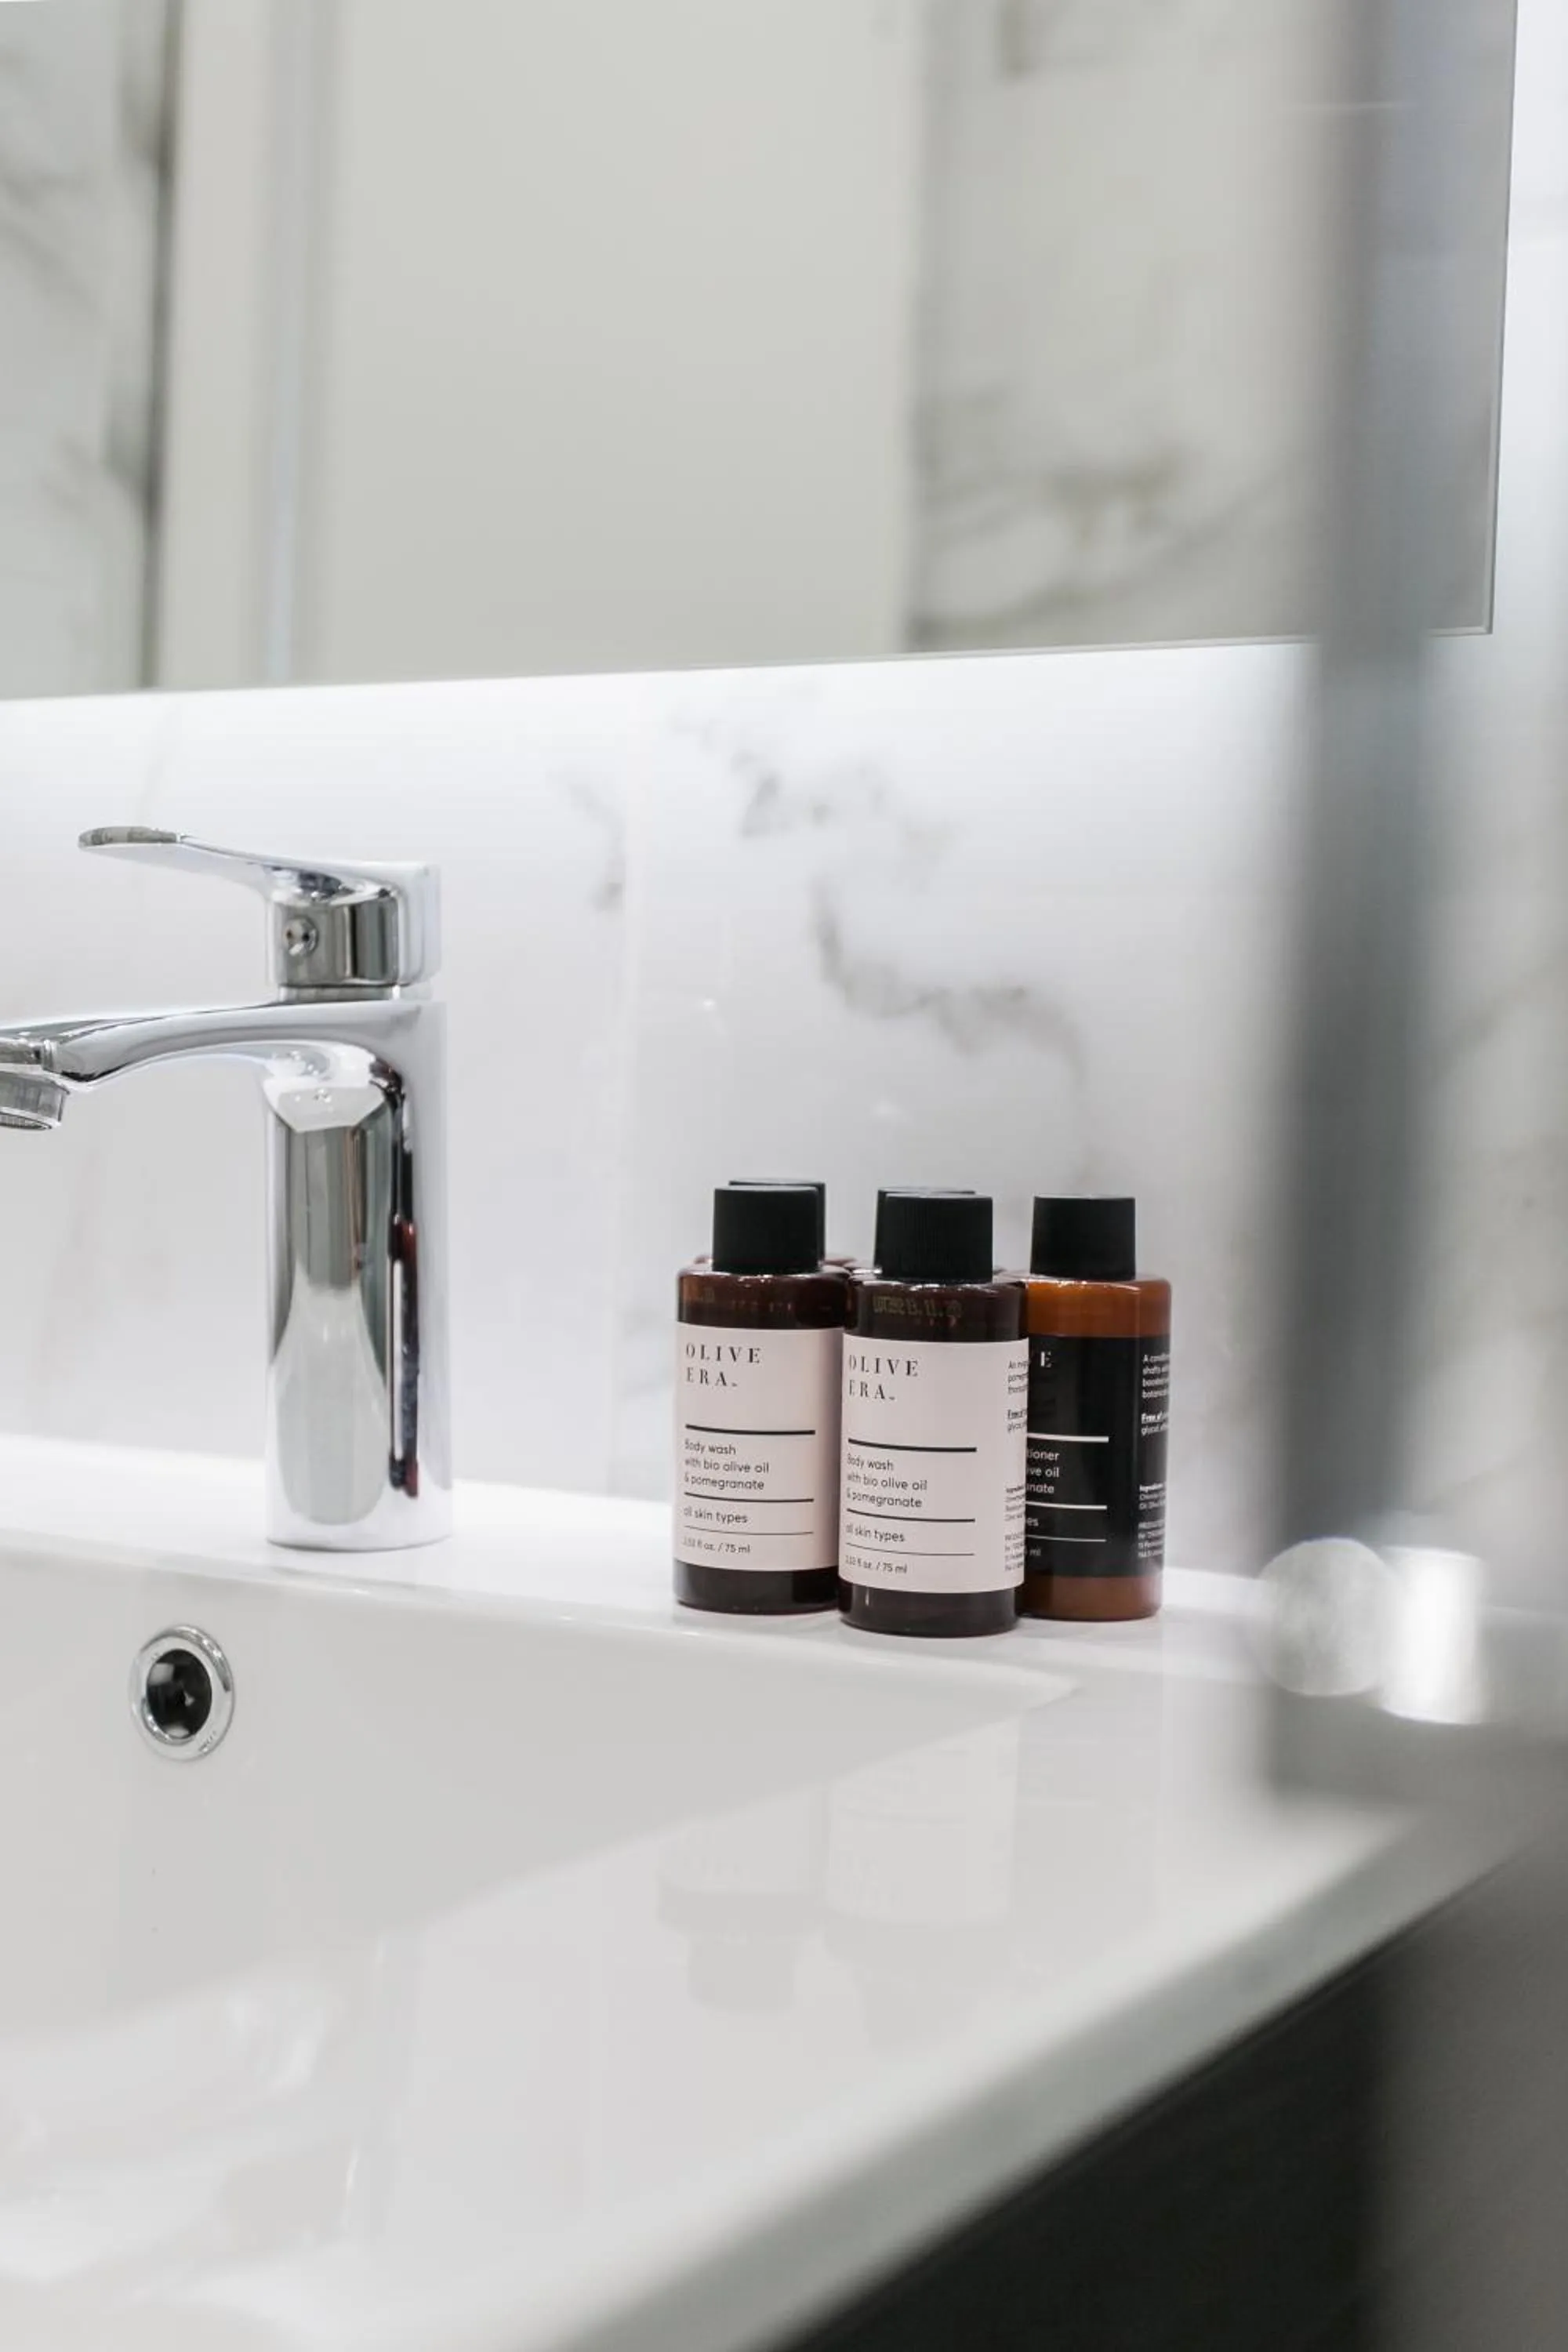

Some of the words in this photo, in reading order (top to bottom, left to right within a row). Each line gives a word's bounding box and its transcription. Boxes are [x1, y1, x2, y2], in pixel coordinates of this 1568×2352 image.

[686, 1342, 760, 1363] OLIVE
[848, 1354, 918, 1377] OLIVE
[684, 1438, 706, 1454] Body
[708, 1445, 736, 1455] wash
[703, 1459, 720, 1471] bio
[723, 1461, 750, 1473] olive
[754, 1461, 769, 1473] oil
[847, 1453, 865, 1468] Body
[868, 1459, 894, 1471] wash
[1045, 1467, 1059, 1478] oil
[691, 1475, 764, 1490] pomegranate
[863, 1474, 879, 1487] bio
[880, 1477, 909, 1490] olive
[912, 1479, 927, 1491] oil
[852, 1492, 923, 1508] pomegranate
[695, 1508, 713, 1520] skin
[716, 1512, 748, 1524] types
[855, 1526, 872, 1537] skin
[874, 1530, 905, 1543] types
[725, 1544, 735, 1553] 75
[738, 1544, 750, 1554] ml
[883, 1563, 893, 1572] 75
[895, 1563, 907, 1574] ml
